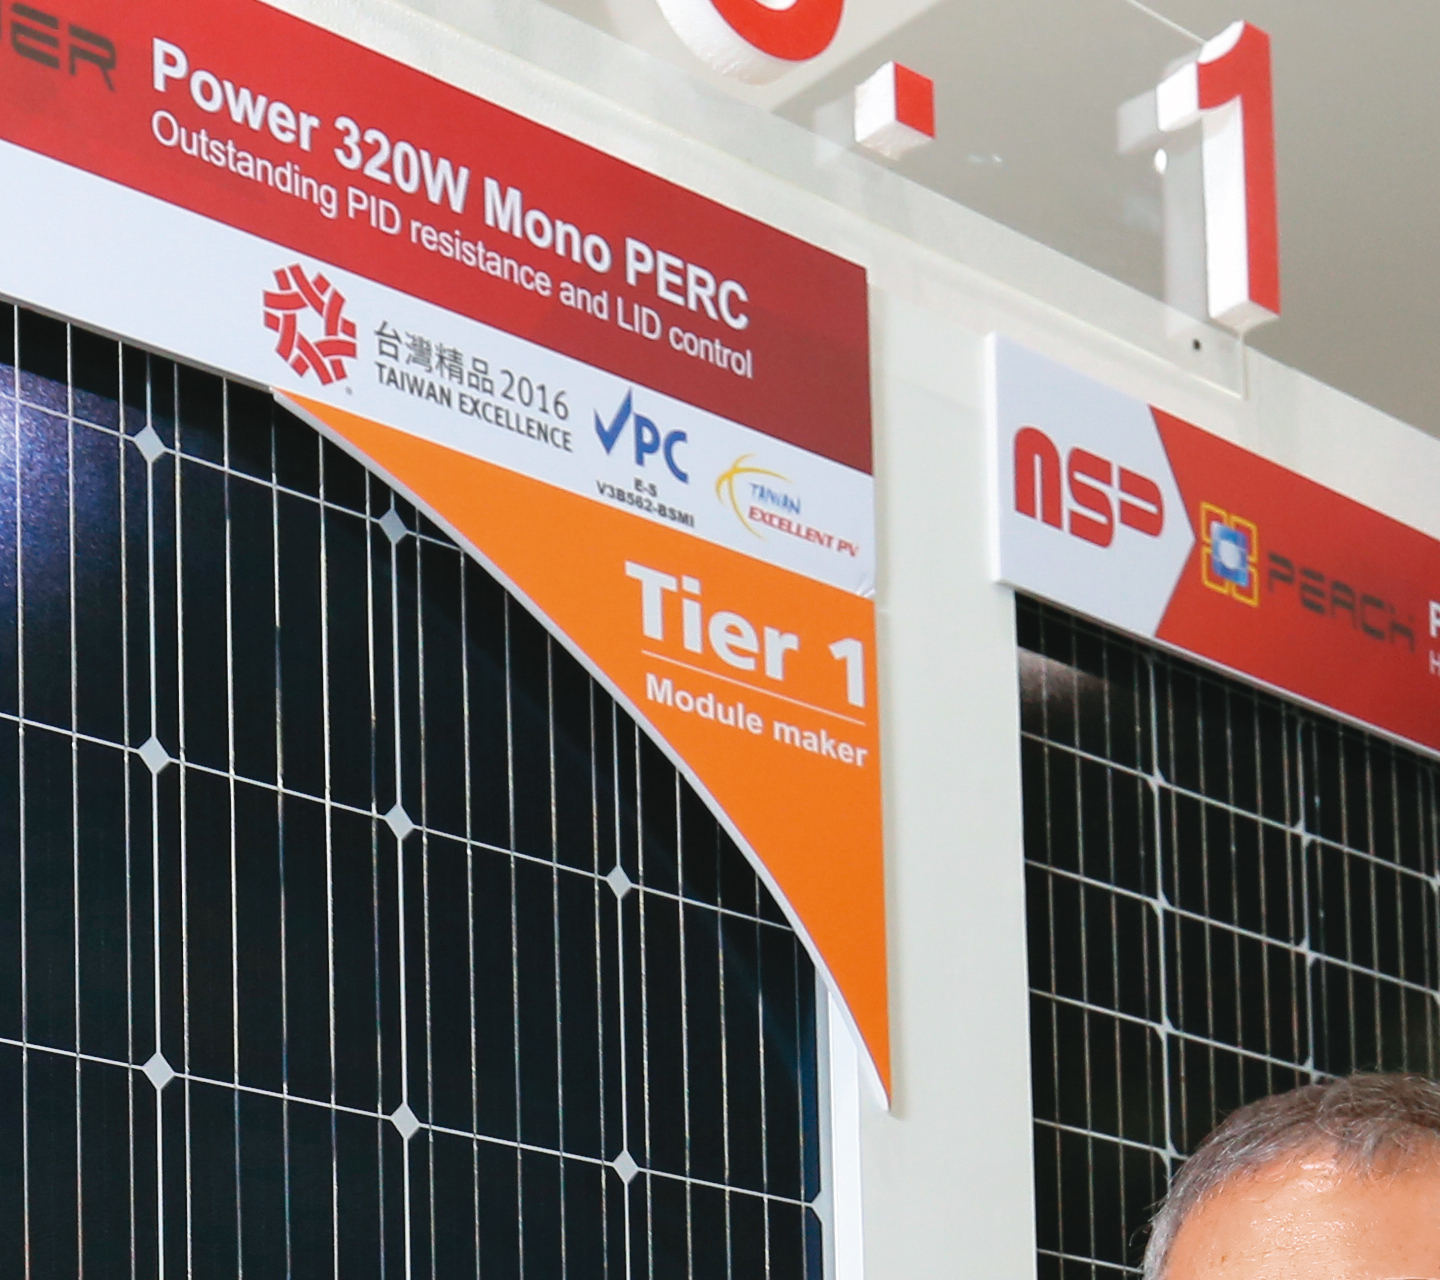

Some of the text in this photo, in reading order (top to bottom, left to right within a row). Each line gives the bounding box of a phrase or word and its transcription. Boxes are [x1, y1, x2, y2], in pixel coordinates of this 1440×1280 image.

[152, 37, 749, 331] Power 320W Mono PERC
[151, 110, 754, 379] Outstanding PID resistance and LID control
[374, 319, 569, 421] 台灣精品 2016
[375, 361, 573, 453] TAIWAN EXCELLENCE
[748, 505, 860, 558] EXCELLENT PV
[625, 560, 866, 709] Tier 1
[645, 672, 869, 768] Module maker
